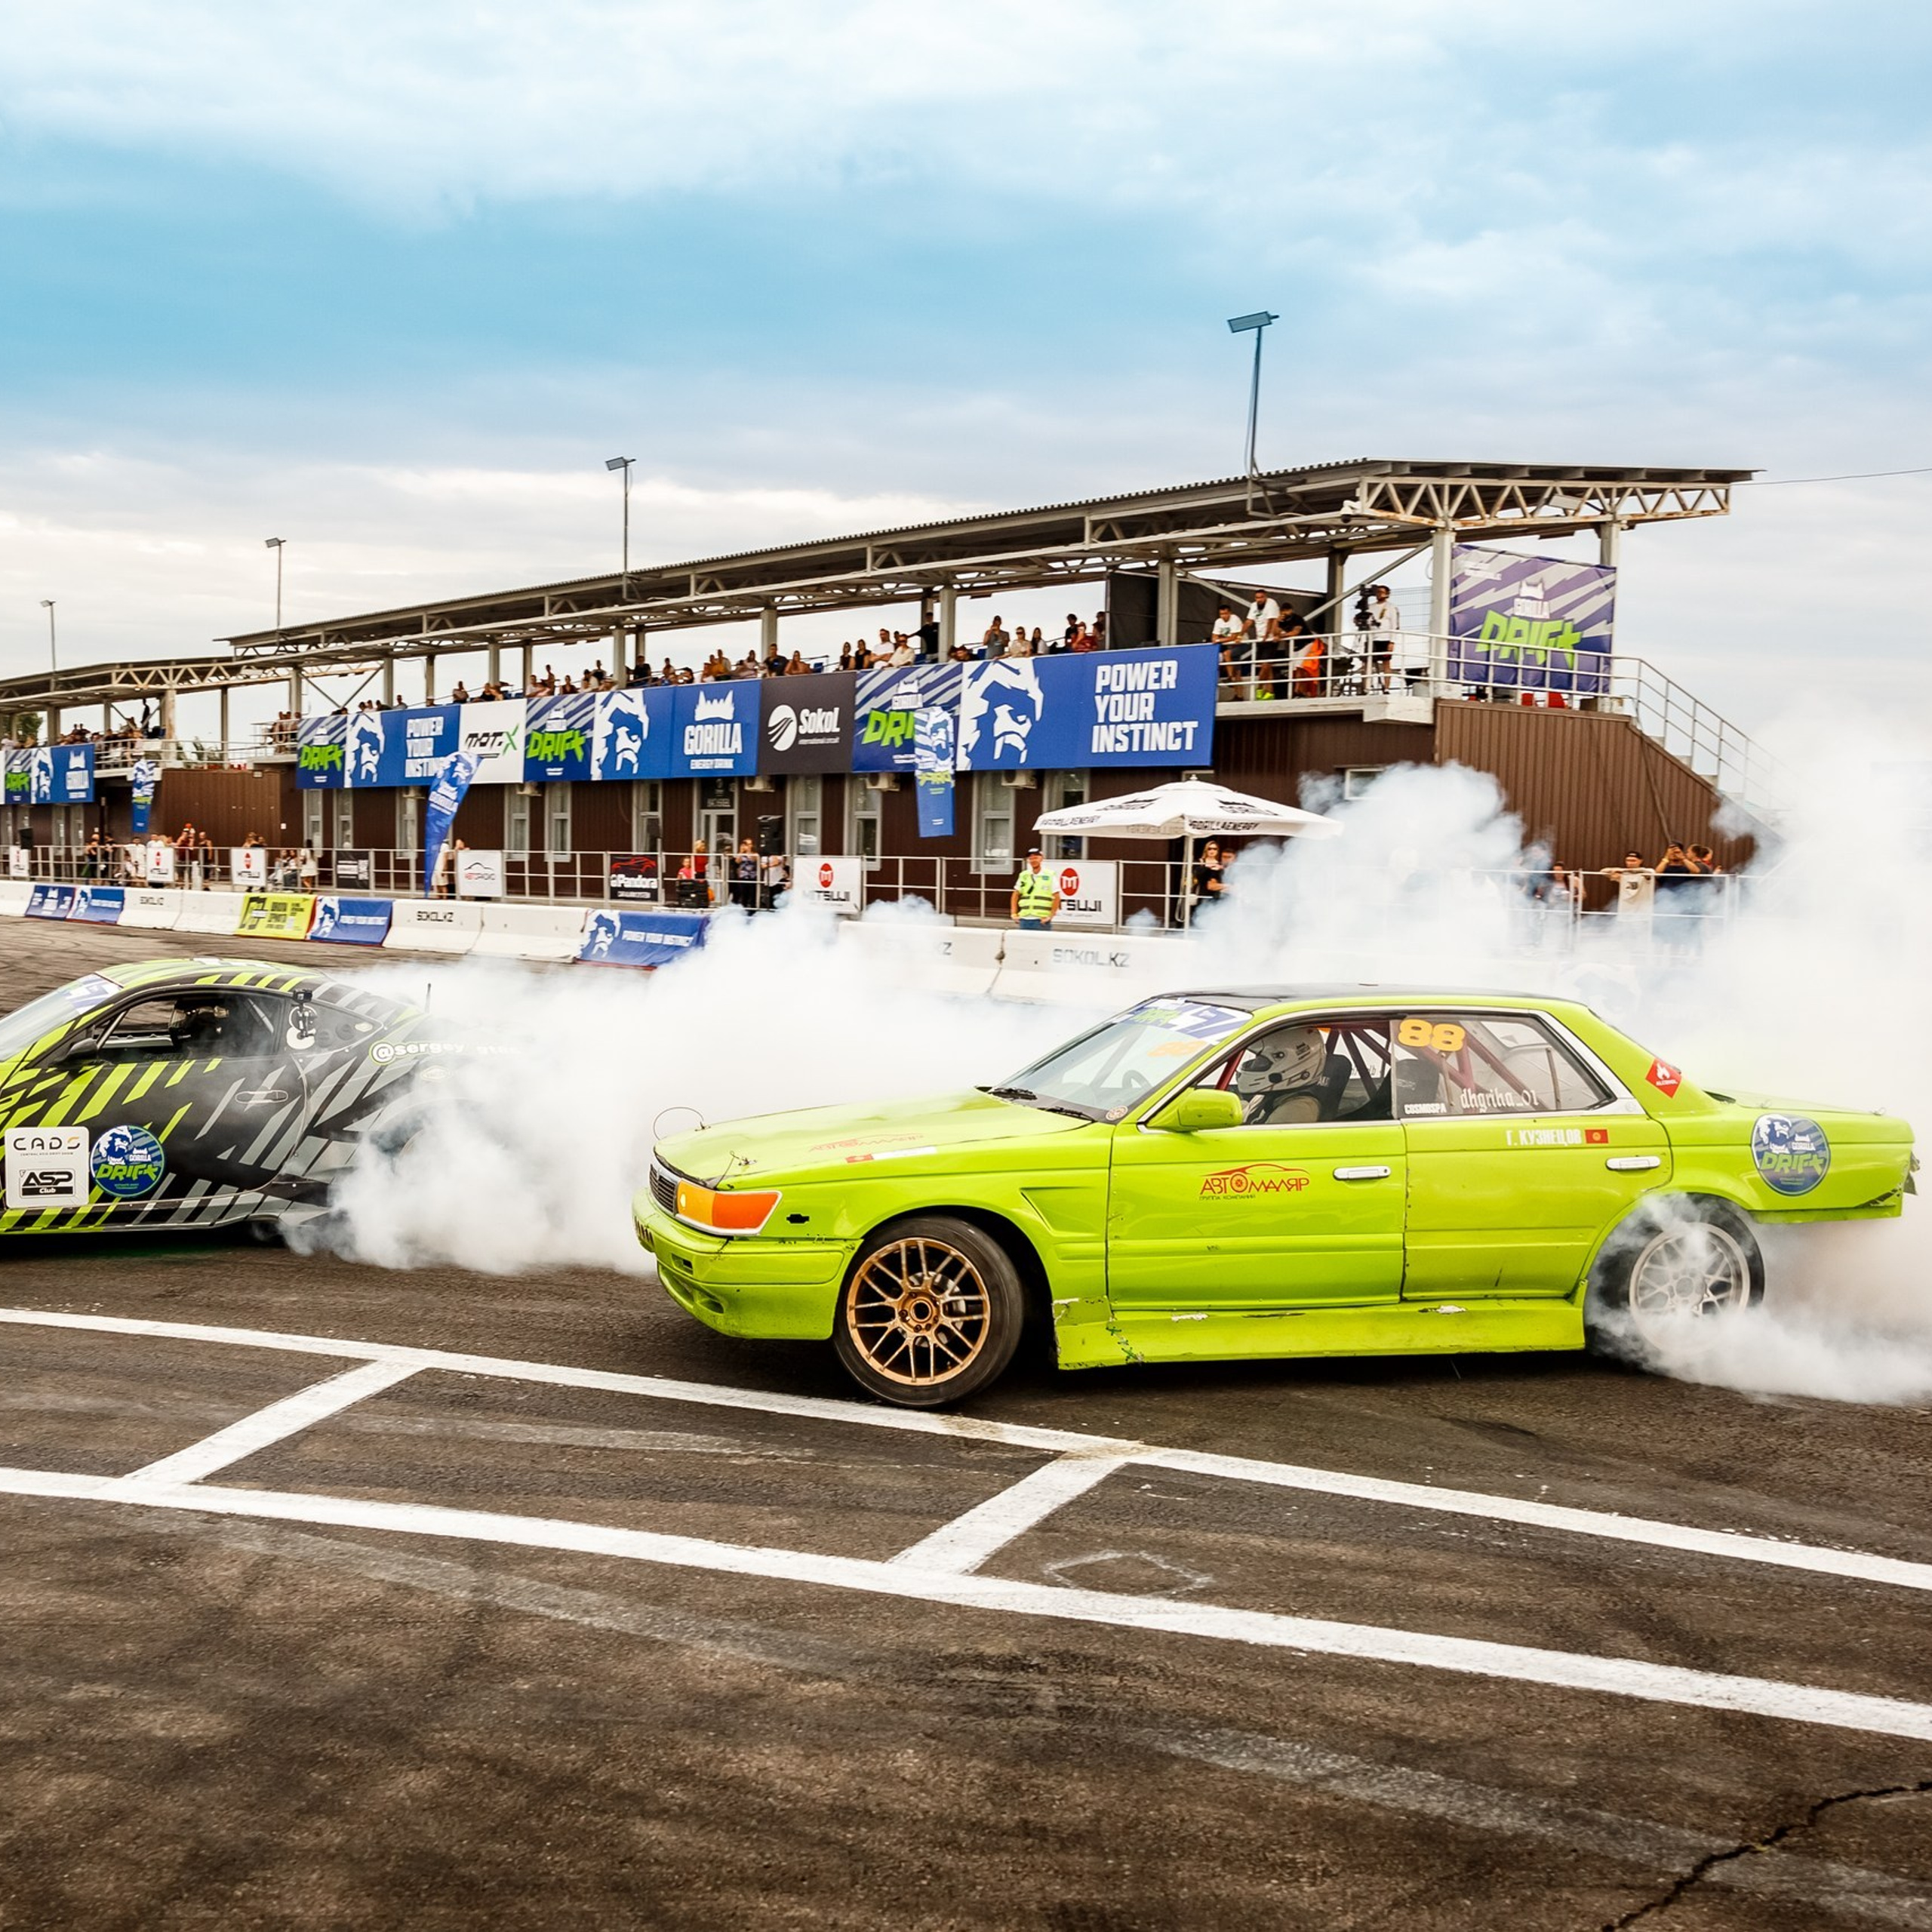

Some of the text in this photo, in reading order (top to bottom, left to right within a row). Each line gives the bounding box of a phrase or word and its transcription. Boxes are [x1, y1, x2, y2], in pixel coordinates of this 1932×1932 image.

[1475, 610, 1583, 670] DRIFT
[1095, 660, 1177, 693] POWER
[1094, 693, 1155, 722] YOUR
[684, 723, 743, 755] GORILLA
[862, 709, 915, 748] DRI
[1091, 721, 1198, 753] INSTINCT
[300, 744, 344, 771] DRIFT
[526, 730, 586, 762] DRIFT
[1059, 899, 1102, 912] TSUJI
[1398, 1019, 1466, 1052] 88
[13, 1137, 81, 1151] CADS
[1518, 1128, 1582, 1146] КУЗНЕЦОВ
[22, 1171, 73, 1187] ASP
[96, 1164, 158, 1182] DRIFT
[1761, 1152, 1825, 1177] DRIFT
